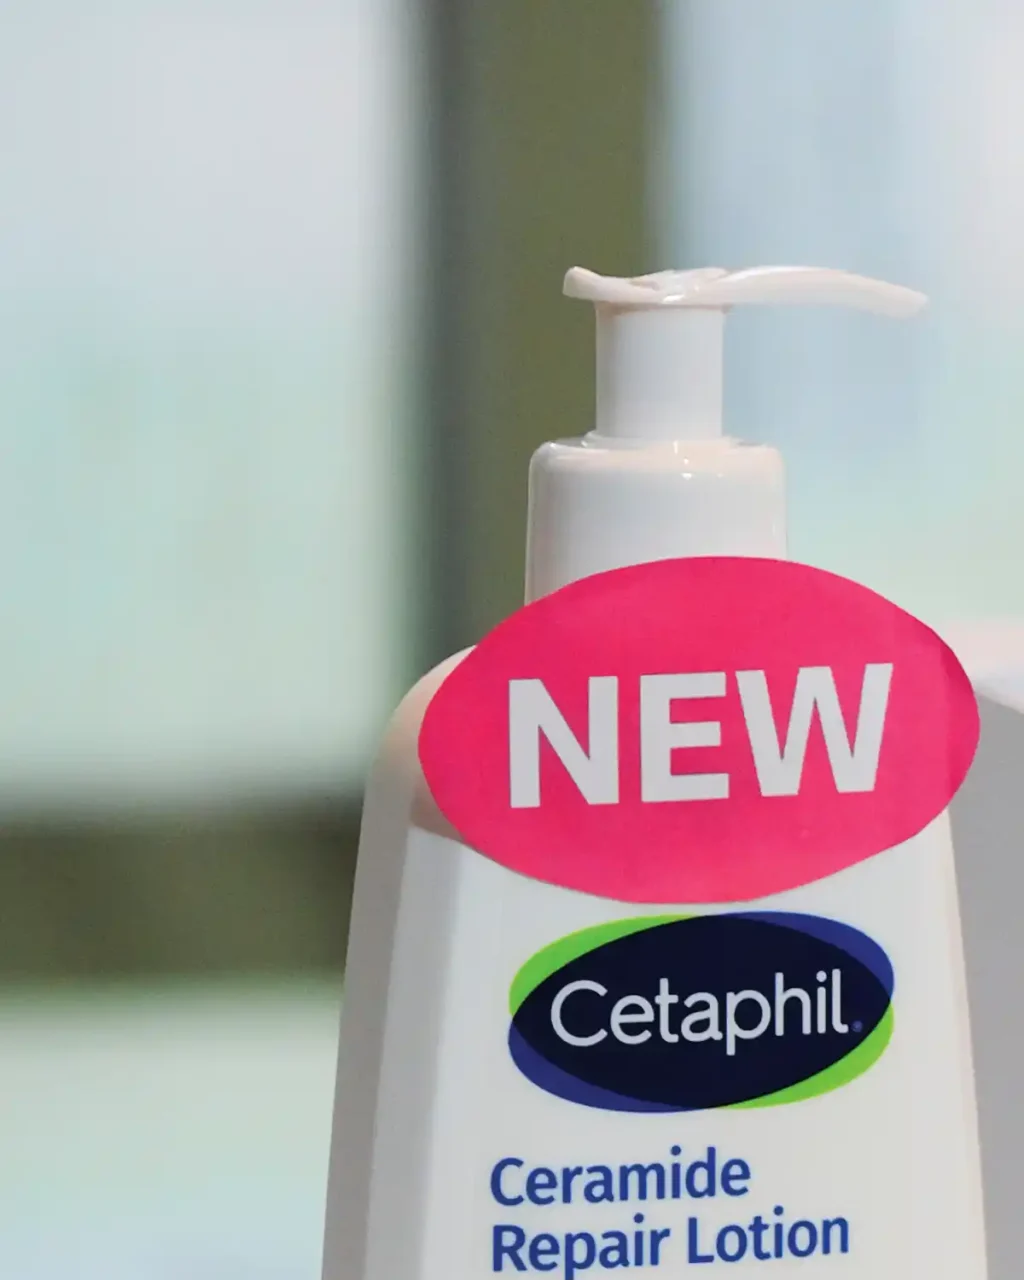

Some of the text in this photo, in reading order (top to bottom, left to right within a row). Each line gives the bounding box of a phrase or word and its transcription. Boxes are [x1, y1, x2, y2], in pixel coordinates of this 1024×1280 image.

[509, 663, 894, 808] NEW
[549, 968, 849, 1056] Cetaphil
[490, 1145, 750, 1206] Ceramide
[688, 1206, 848, 1263] Lotion
